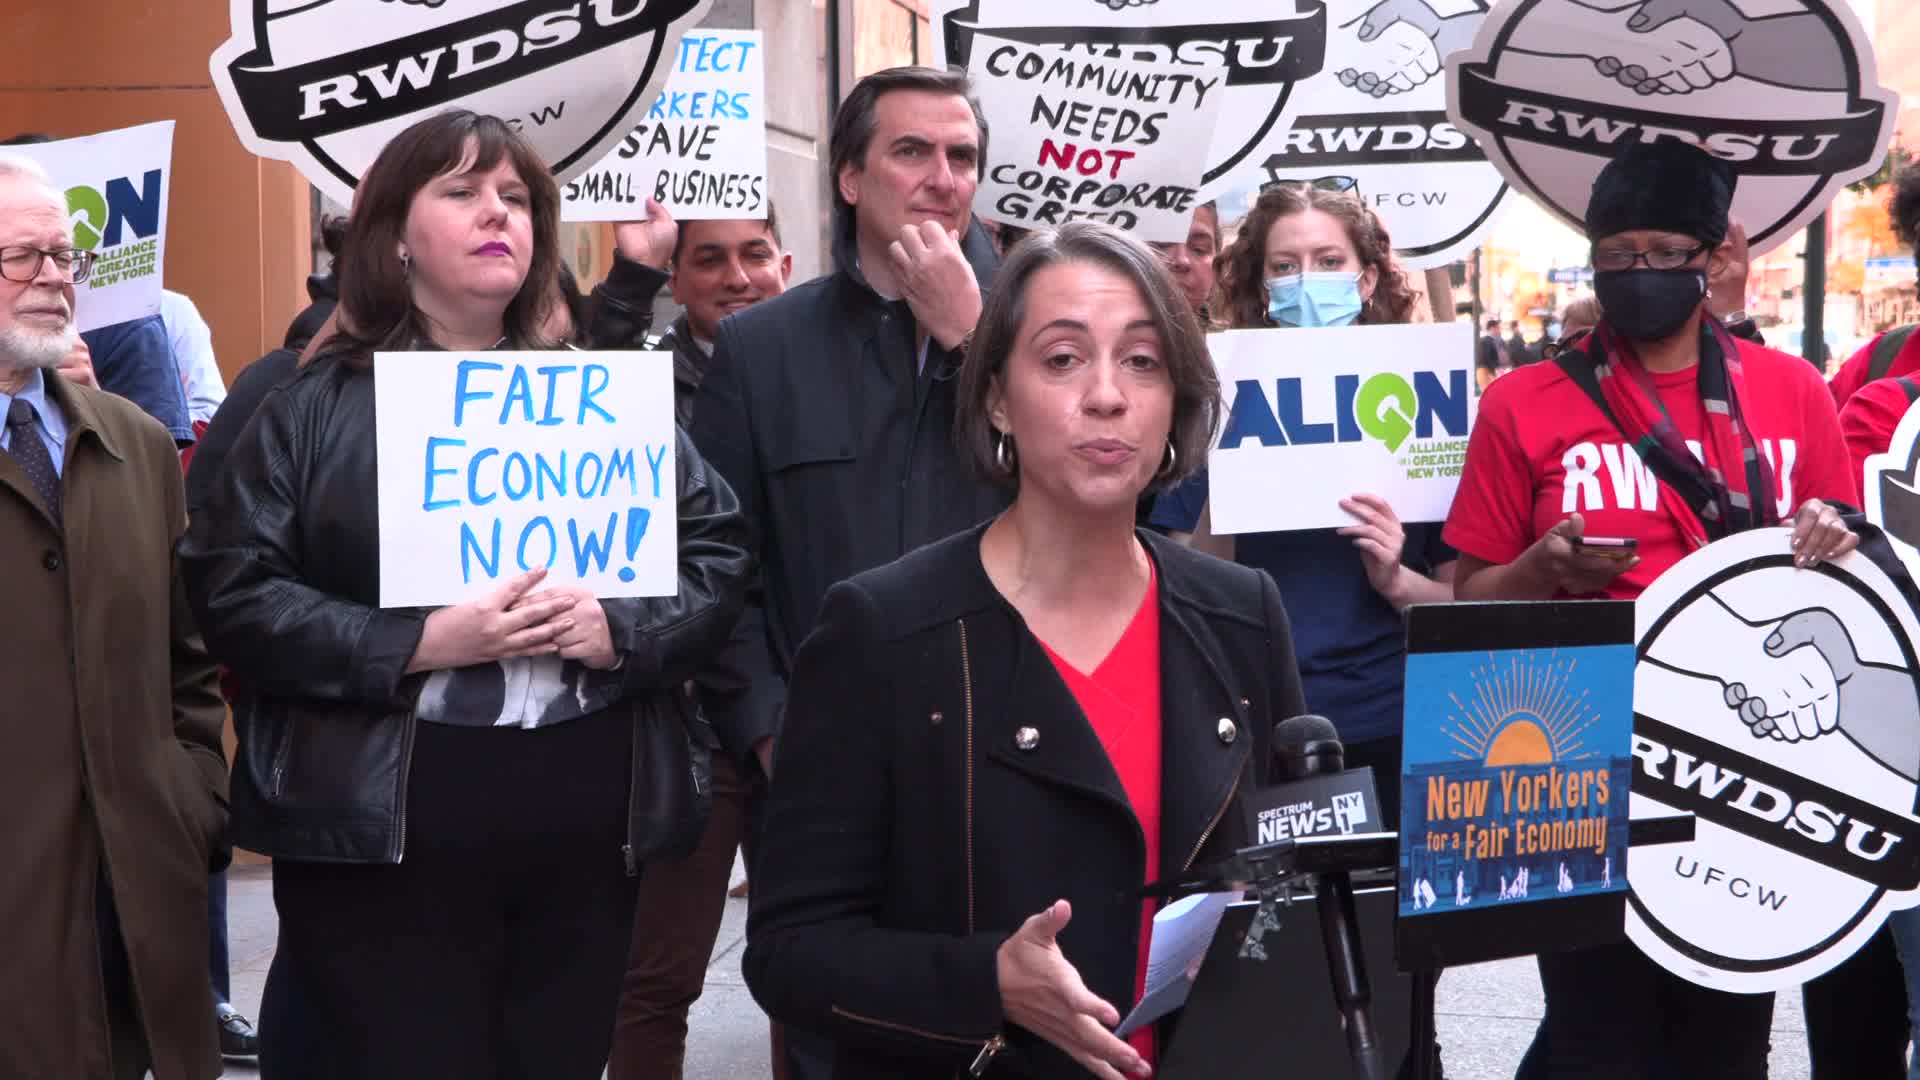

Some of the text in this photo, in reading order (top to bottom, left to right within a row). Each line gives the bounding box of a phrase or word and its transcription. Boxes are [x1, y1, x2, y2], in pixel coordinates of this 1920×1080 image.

[298, 0, 648, 120] RWDSU
[676, 37, 755, 73] TECT
[985, 44, 1220, 110] COMMUNITY
[648, 88, 750, 120] RKERS
[1030, 94, 1168, 146] NEEDS
[617, 121, 720, 161] SAVE
[1277, 121, 1468, 155] RWDS
[1037, 138, 1136, 181] NOT
[565, 172, 636, 205] SMALL
[654, 169, 762, 211] BUSINESS
[990, 164, 1198, 213] CORPORATE
[1363, 191, 1448, 208] FCW
[89, 263, 155, 290] NEW YORK
[97, 252, 156, 276] GREATER
[454, 359, 617, 428] FAIR
[1408, 441, 1468, 454] ALLIANCE
[422, 436, 667, 512] ECONOMY
[1407, 466, 1462, 479] NEW YOR
[460, 507, 651, 585] NOW!
[1257, 800, 1313, 821] SPECTRUM
[1337, 794, 1360, 810] NY
[1427, 766, 1610, 822] New Yorkers
[1632, 733, 1902, 871] RWDSU
[1257, 807, 1332, 845] NEWS
[1427, 816, 1607, 861] for a Fair Economy
[1675, 855, 1788, 912] UFCW
